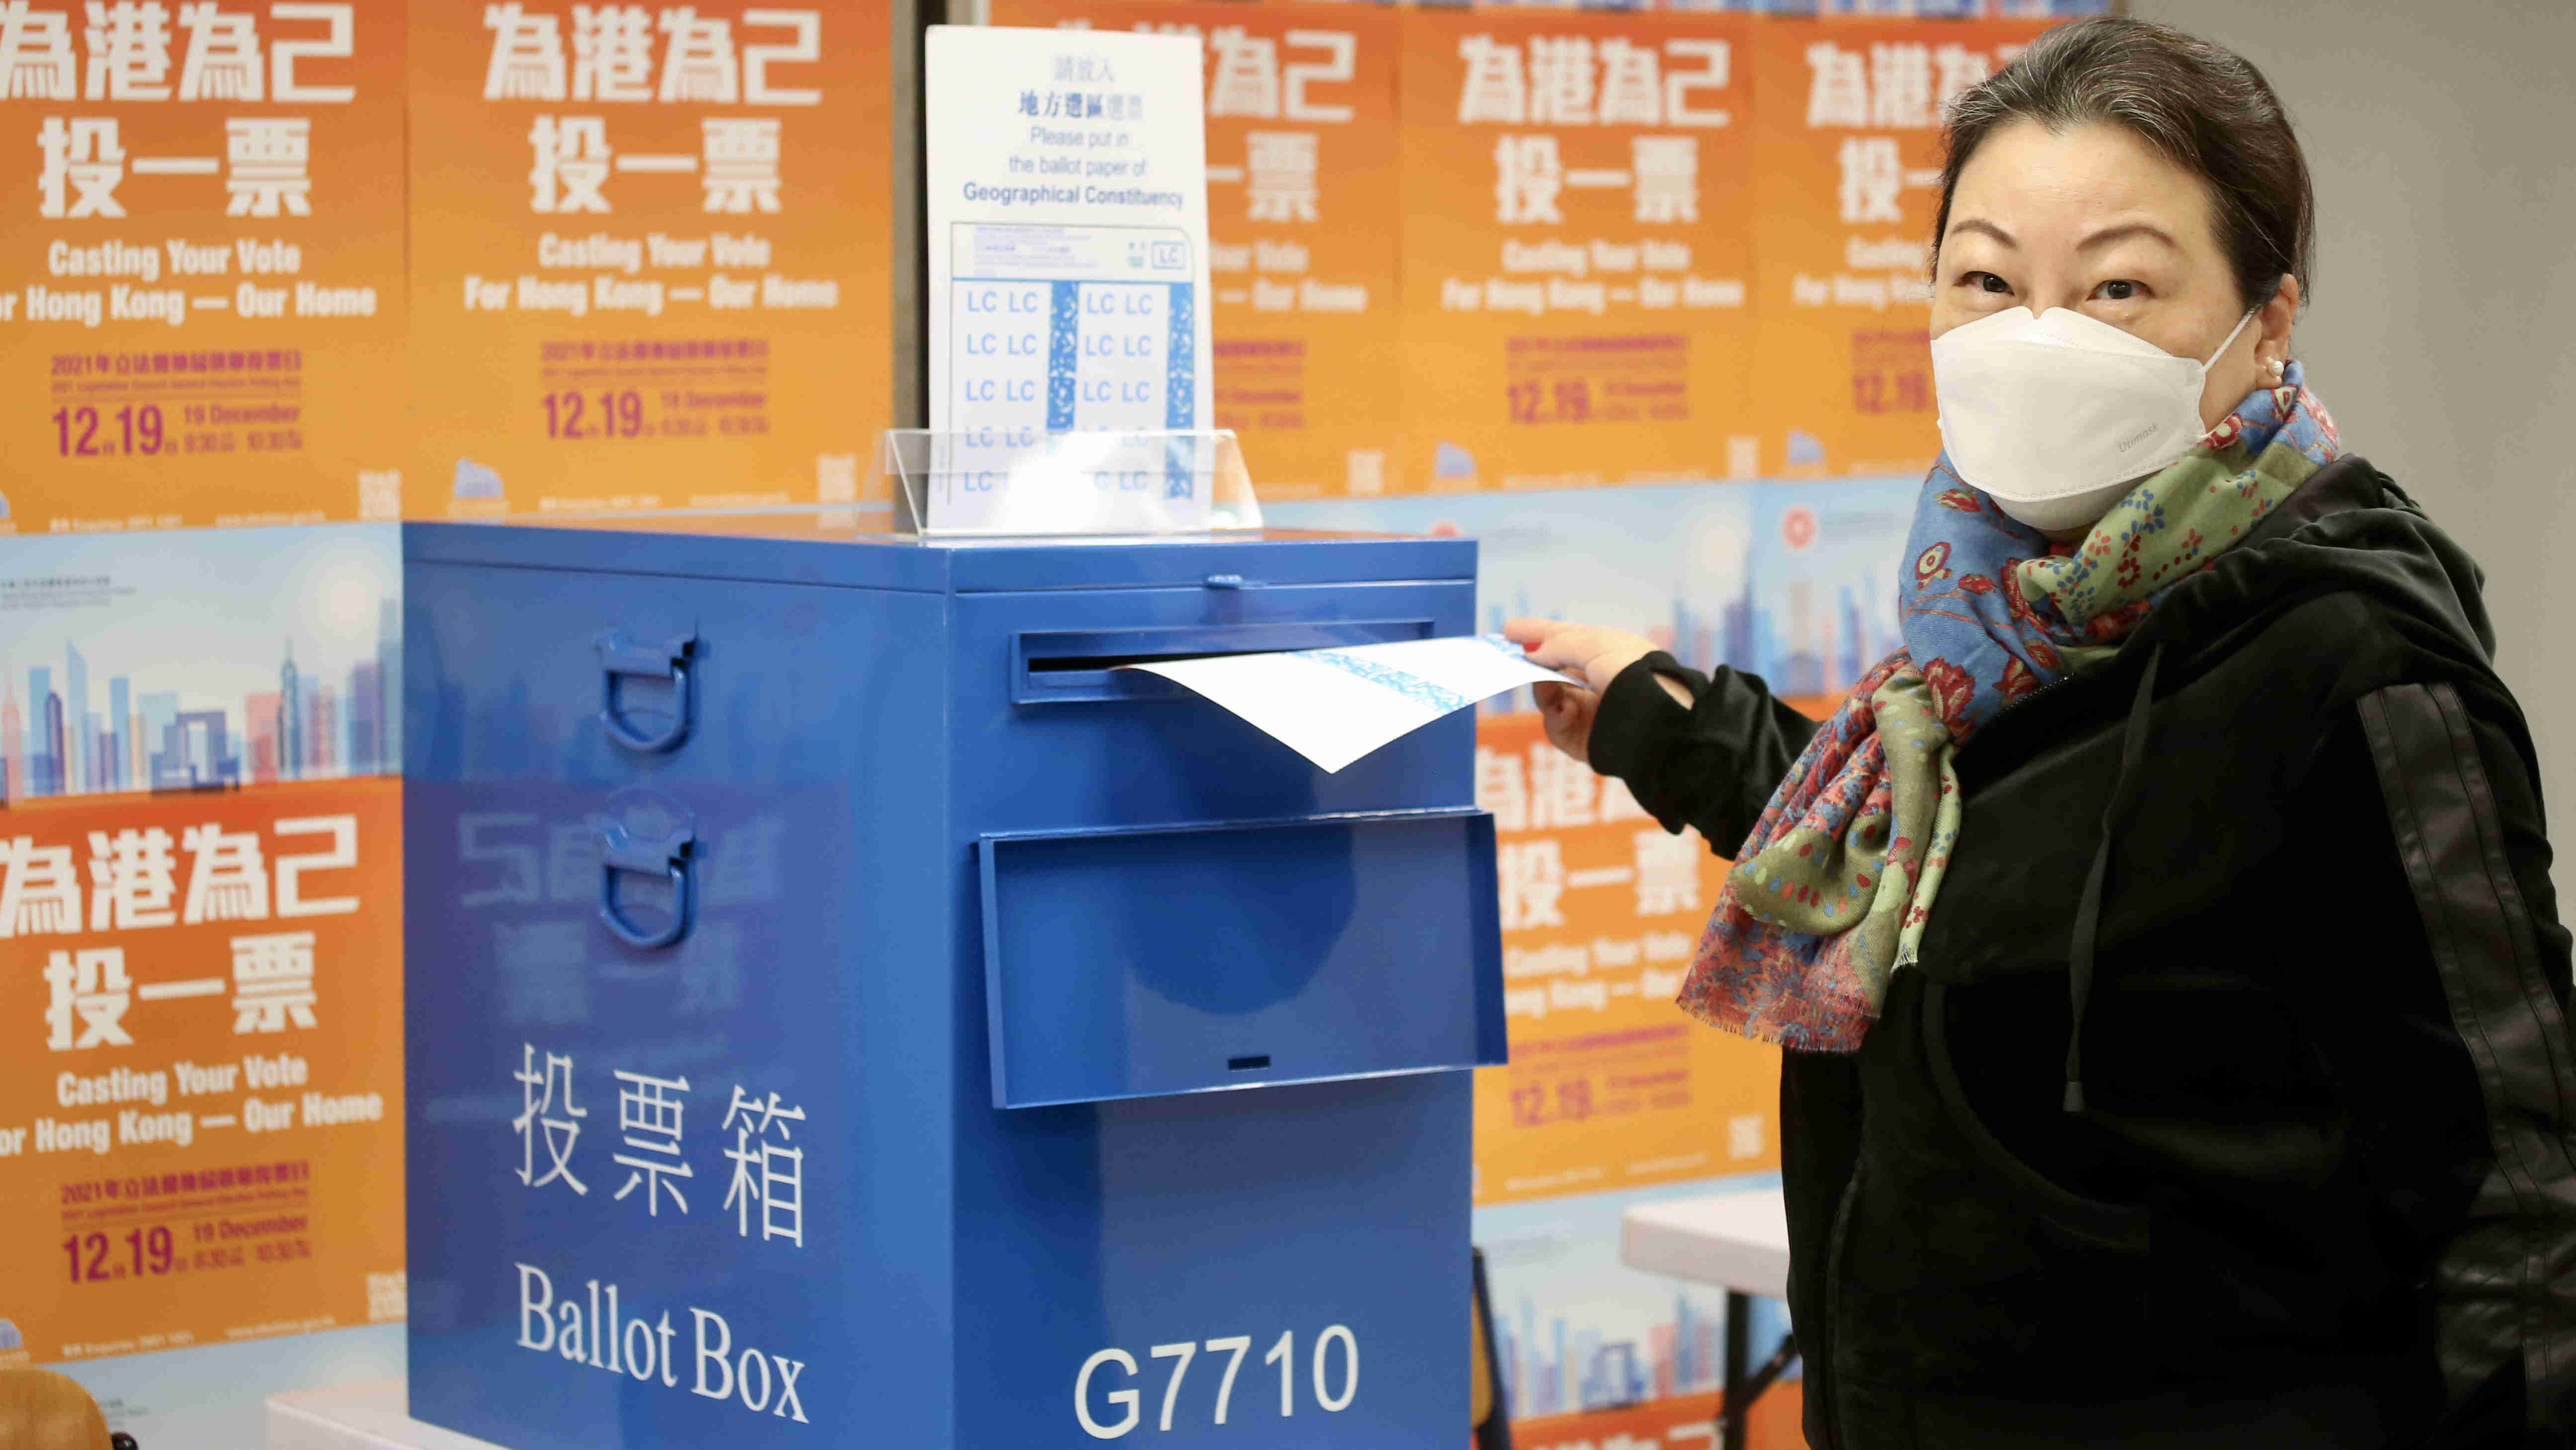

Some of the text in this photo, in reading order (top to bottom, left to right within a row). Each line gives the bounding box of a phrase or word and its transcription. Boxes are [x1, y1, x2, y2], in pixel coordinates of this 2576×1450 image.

[0, 0, 356, 102] 為港為己
[483, 2, 822, 104] 為港為己
[528, 115, 782, 213] 投一票
[1030, 125, 1129, 148] Please put in
[36, 117, 312, 218] 投一票
[1009, 156, 1147, 178] the ballot paper of
[963, 181, 1184, 211] Geographical Constituency
[48, 238, 302, 282] Casting Your Vote
[538, 232, 642, 274] Casting
[26, 284, 102, 328] Hong
[110, 283, 185, 326] Kong
[236, 281, 289, 318] Our
[295, 281, 377, 317] Home
[967, 291, 1152, 315] LC LC LC LC
[966, 333, 1152, 357] LC LC LC LC
[965, 379, 1151, 402] LC LC LC LC
[963, 470, 993, 492] LC
[0, 814, 359, 939] 為港為己
[43, 930, 318, 1052] 投一票
[57, 1052, 308, 1107] Casting Your Vote
[35, 1116, 110, 1155] Hong
[118, 1108, 193, 1147] Kong
[244, 1097, 295, 1133] Our
[301, 1092, 383, 1127] Home
[512, 1042, 806, 1249] 投票箱
[515, 1262, 810, 1424] Ballot Box
[1075, 1324, 1359, 1440] G7710
